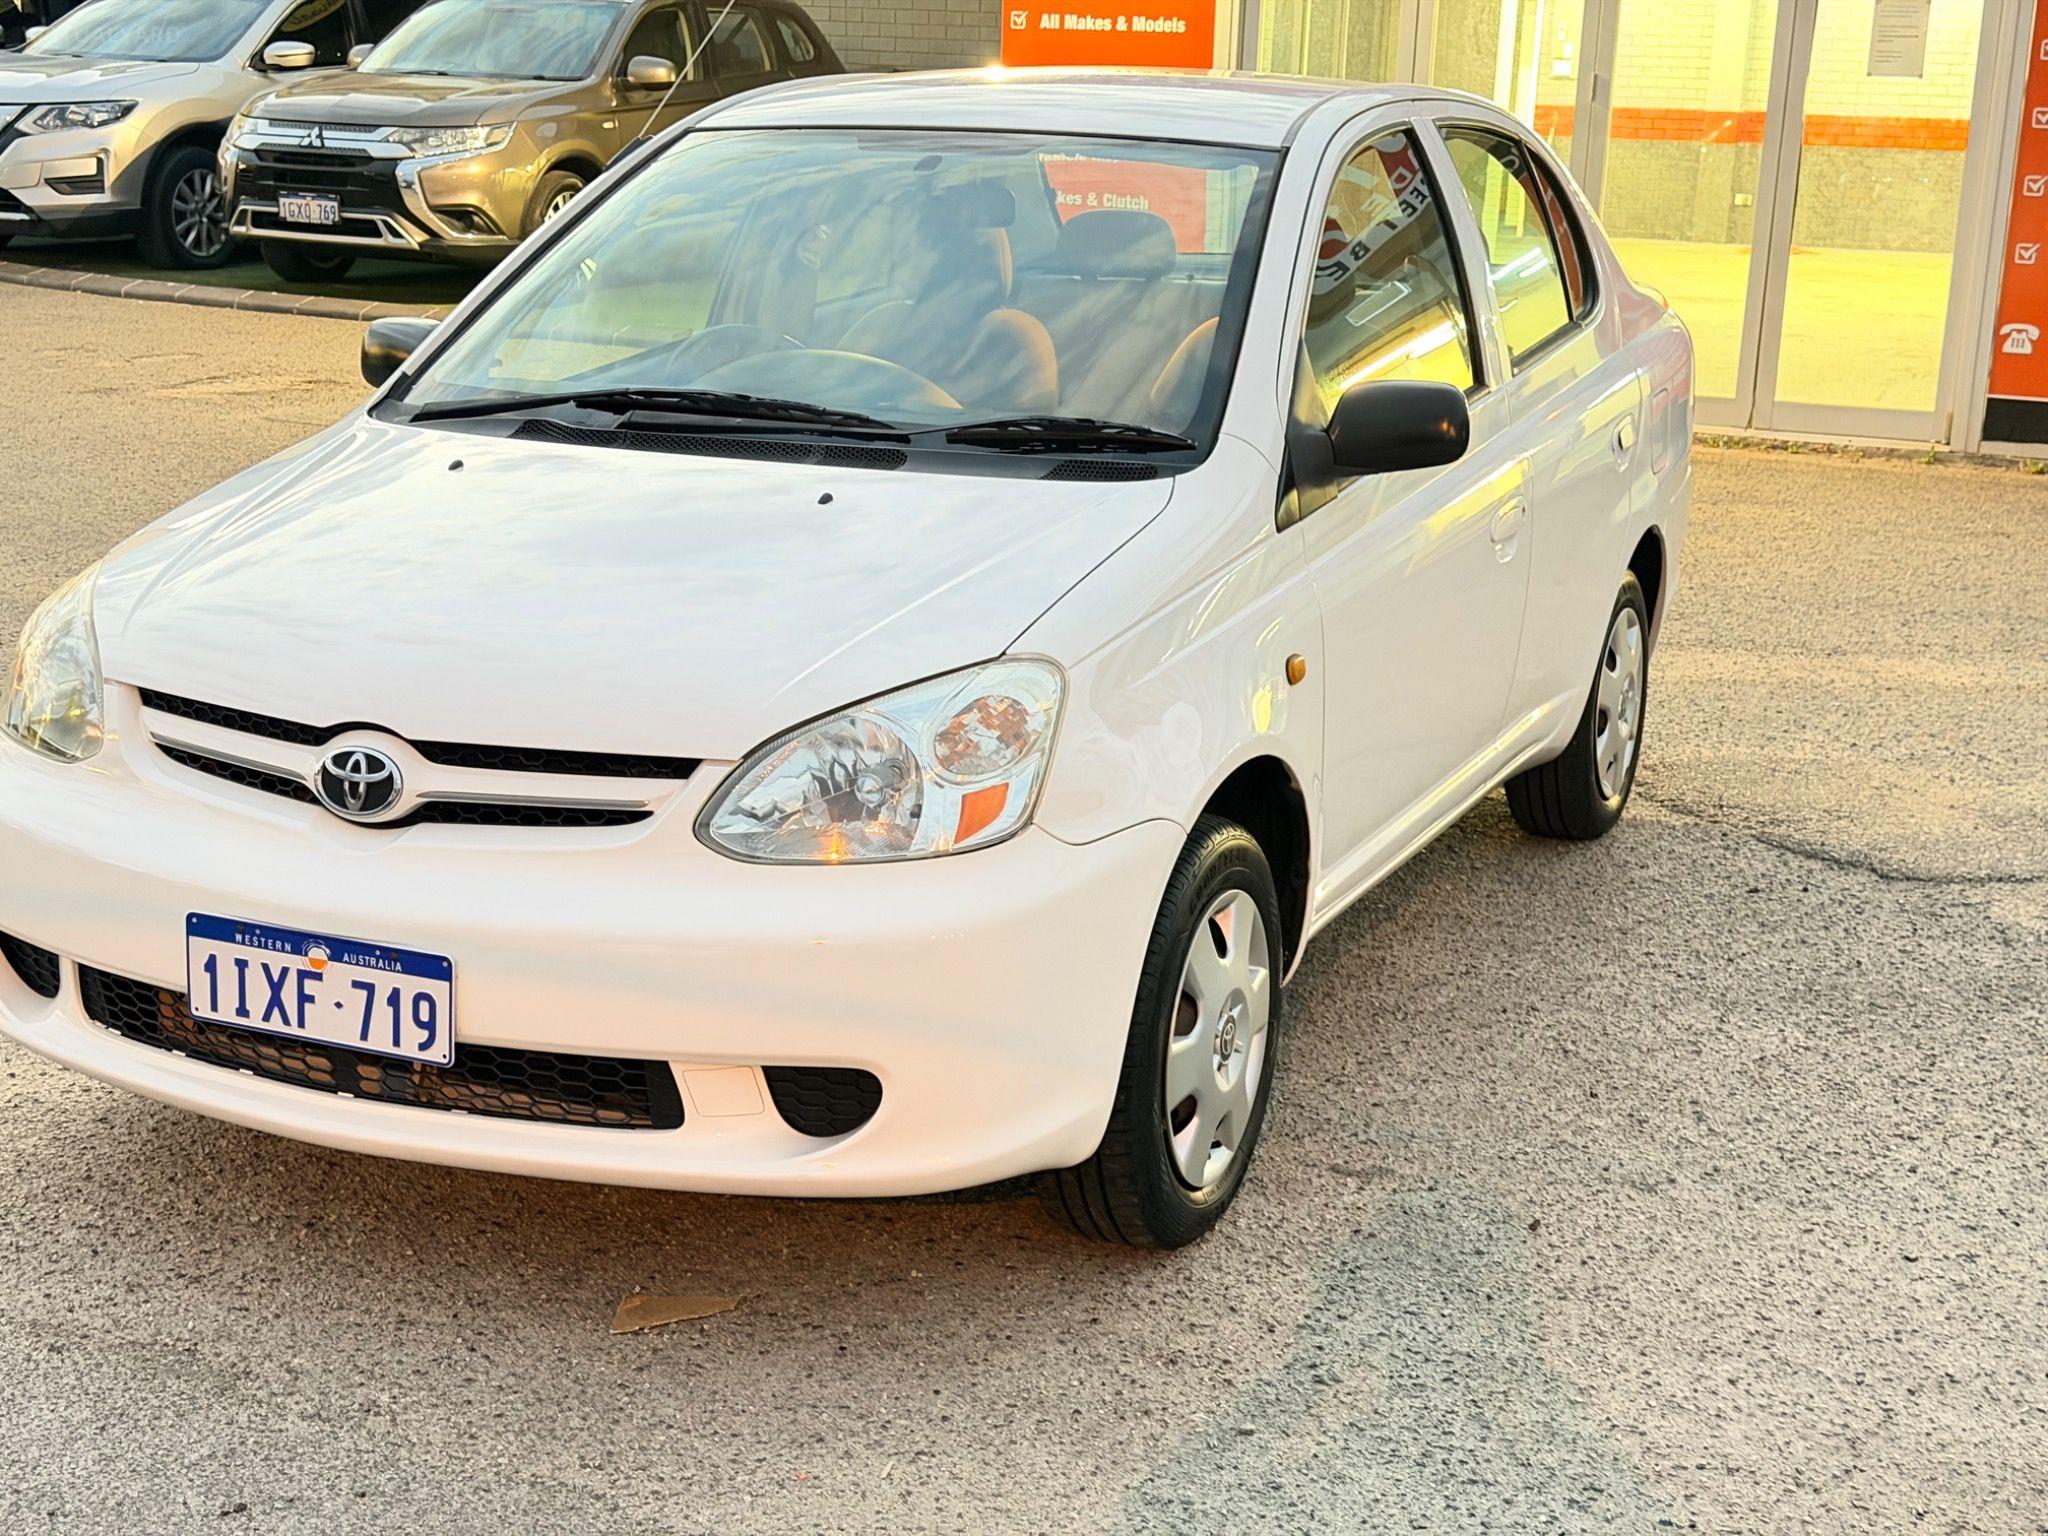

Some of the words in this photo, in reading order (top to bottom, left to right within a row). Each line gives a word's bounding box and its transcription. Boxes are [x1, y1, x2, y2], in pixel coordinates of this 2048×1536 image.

[1040, 13, 1060, 30] All
[1064, 14, 1112, 32] Makes
[1115, 15, 1128, 32] &
[1132, 16, 1186, 34] Models
[1087, 191, 1098, 207] &
[1103, 193, 1149, 210] Clutch
[234, 932, 291, 953] WESTERN
[342, 952, 403, 972] AUSTRALIA
